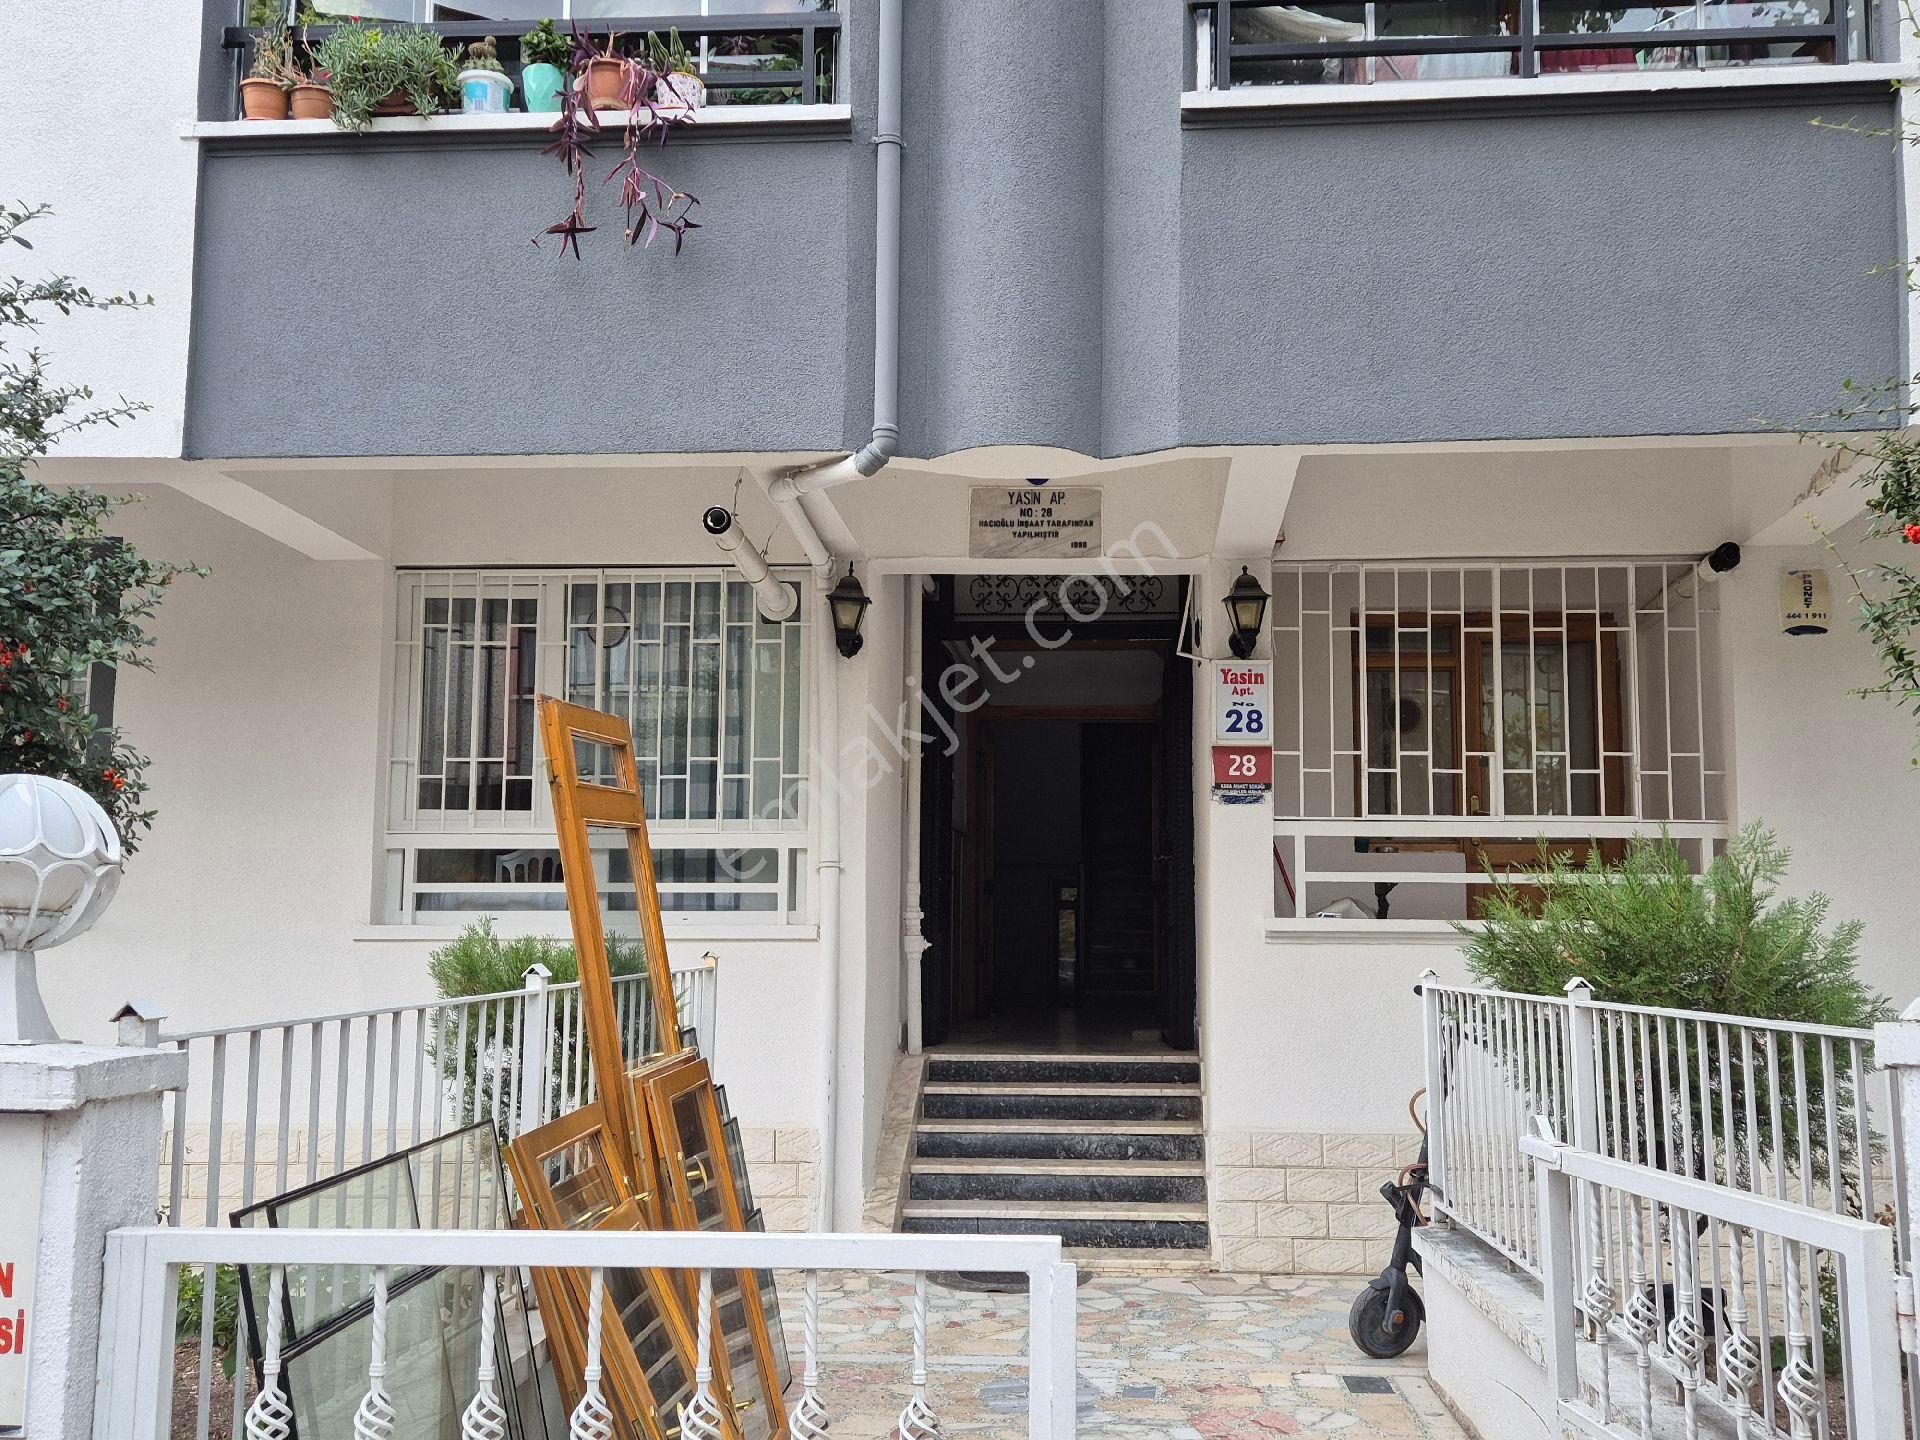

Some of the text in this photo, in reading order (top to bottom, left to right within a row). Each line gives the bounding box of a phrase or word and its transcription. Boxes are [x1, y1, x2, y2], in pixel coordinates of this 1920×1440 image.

[1041, 507, 1053, 517] 28
[1220, 668, 1265, 685] Yasin
[1231, 685, 1254, 697] Apt.
[1225, 709, 1264, 733] 28
[1228, 754, 1257, 777] 28
